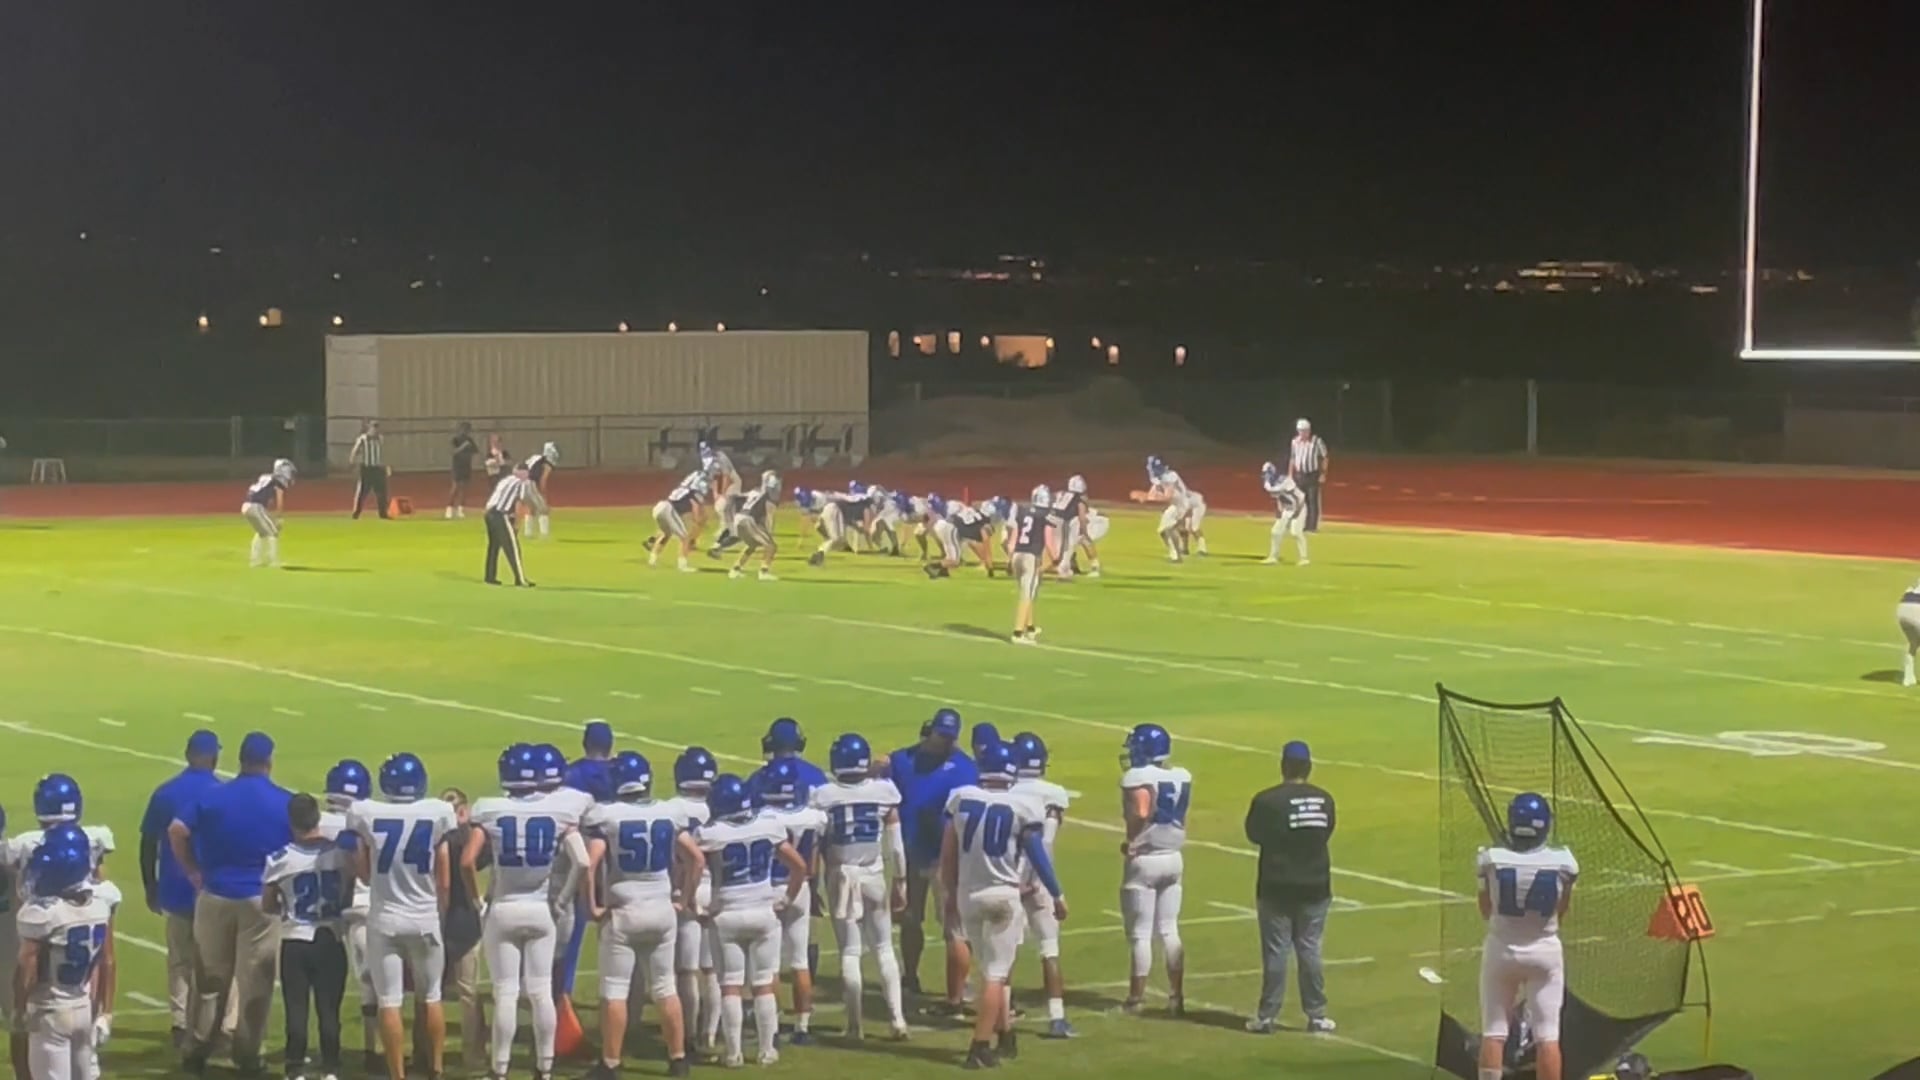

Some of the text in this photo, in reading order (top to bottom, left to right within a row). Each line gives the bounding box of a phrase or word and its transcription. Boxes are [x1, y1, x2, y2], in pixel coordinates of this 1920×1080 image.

[1019, 516, 1034, 544] 2
[373, 818, 434, 875] 74
[496, 815, 556, 867] 10
[959, 799, 1015, 857] 70
[1496, 868, 1558, 917] 14
